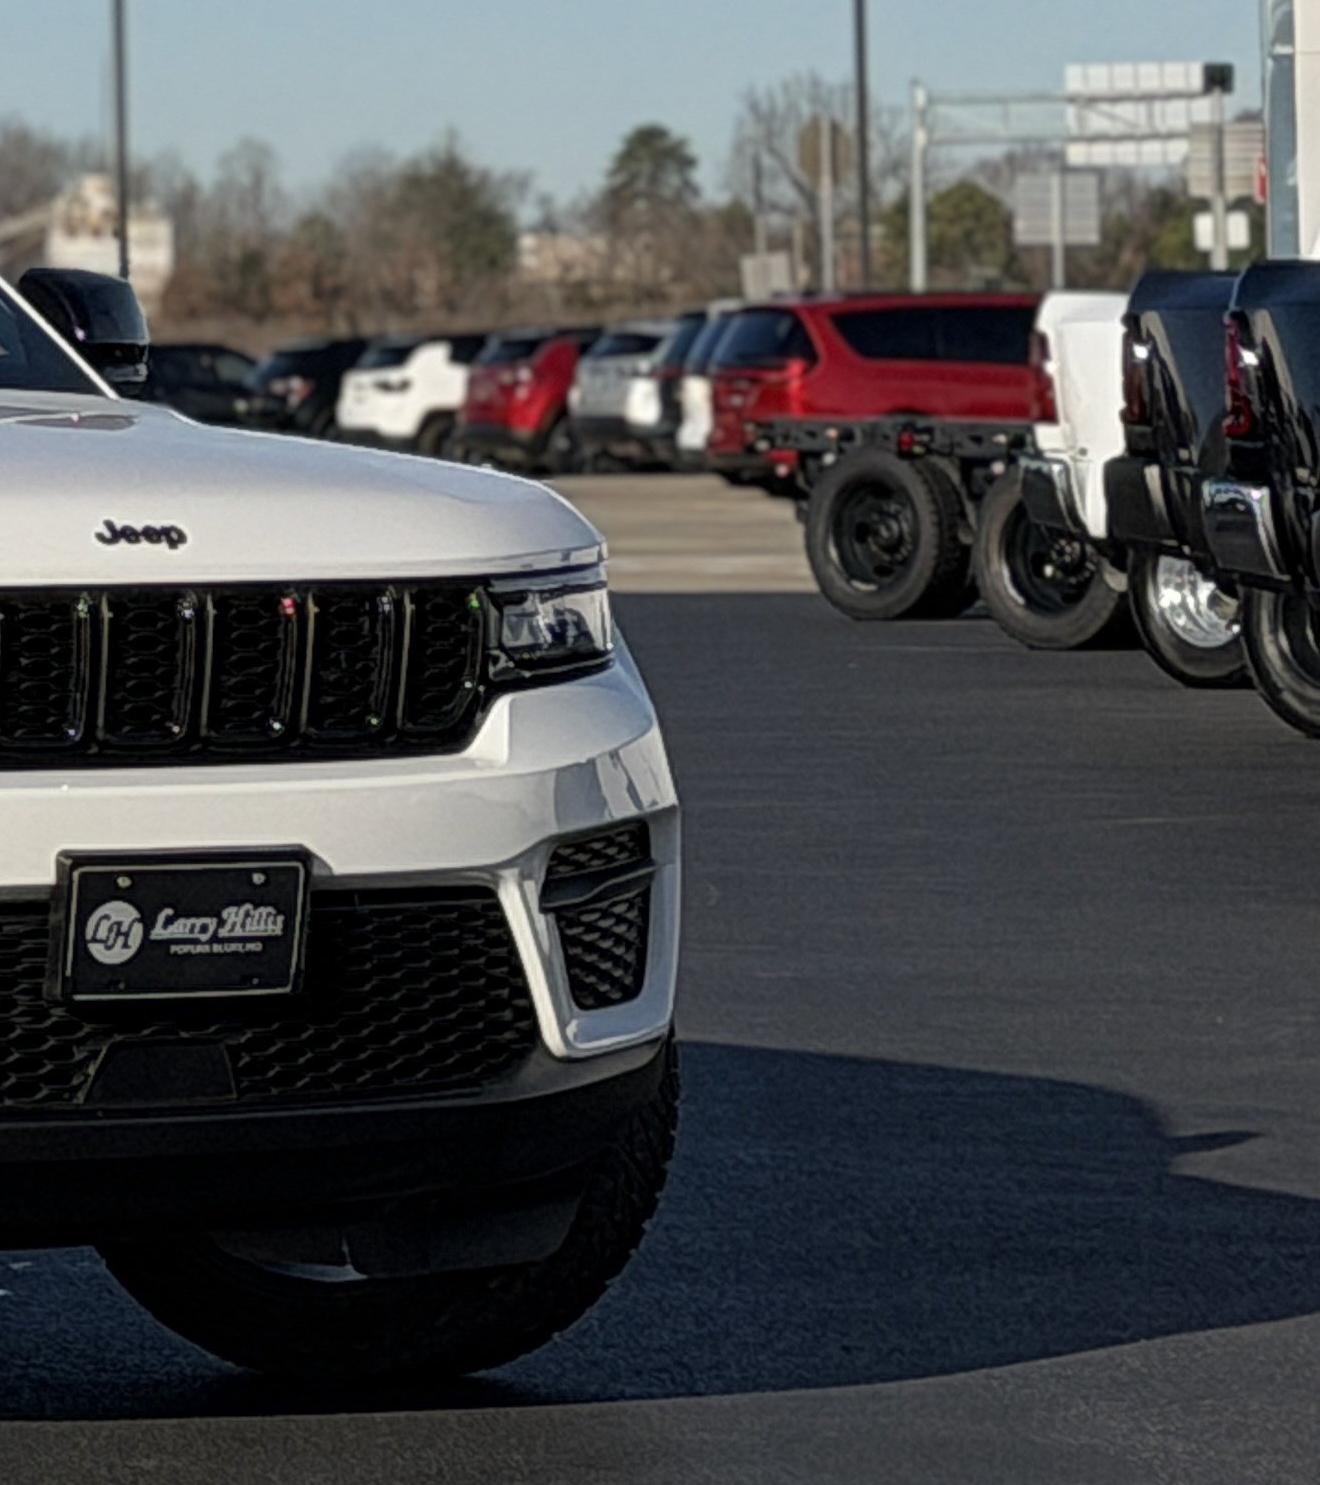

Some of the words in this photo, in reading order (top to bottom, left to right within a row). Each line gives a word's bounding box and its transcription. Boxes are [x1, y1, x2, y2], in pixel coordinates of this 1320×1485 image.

[94, 519, 188, 550] Jeep
[149, 907, 218, 942] Larry
[217, 902, 285, 937] Hillis
